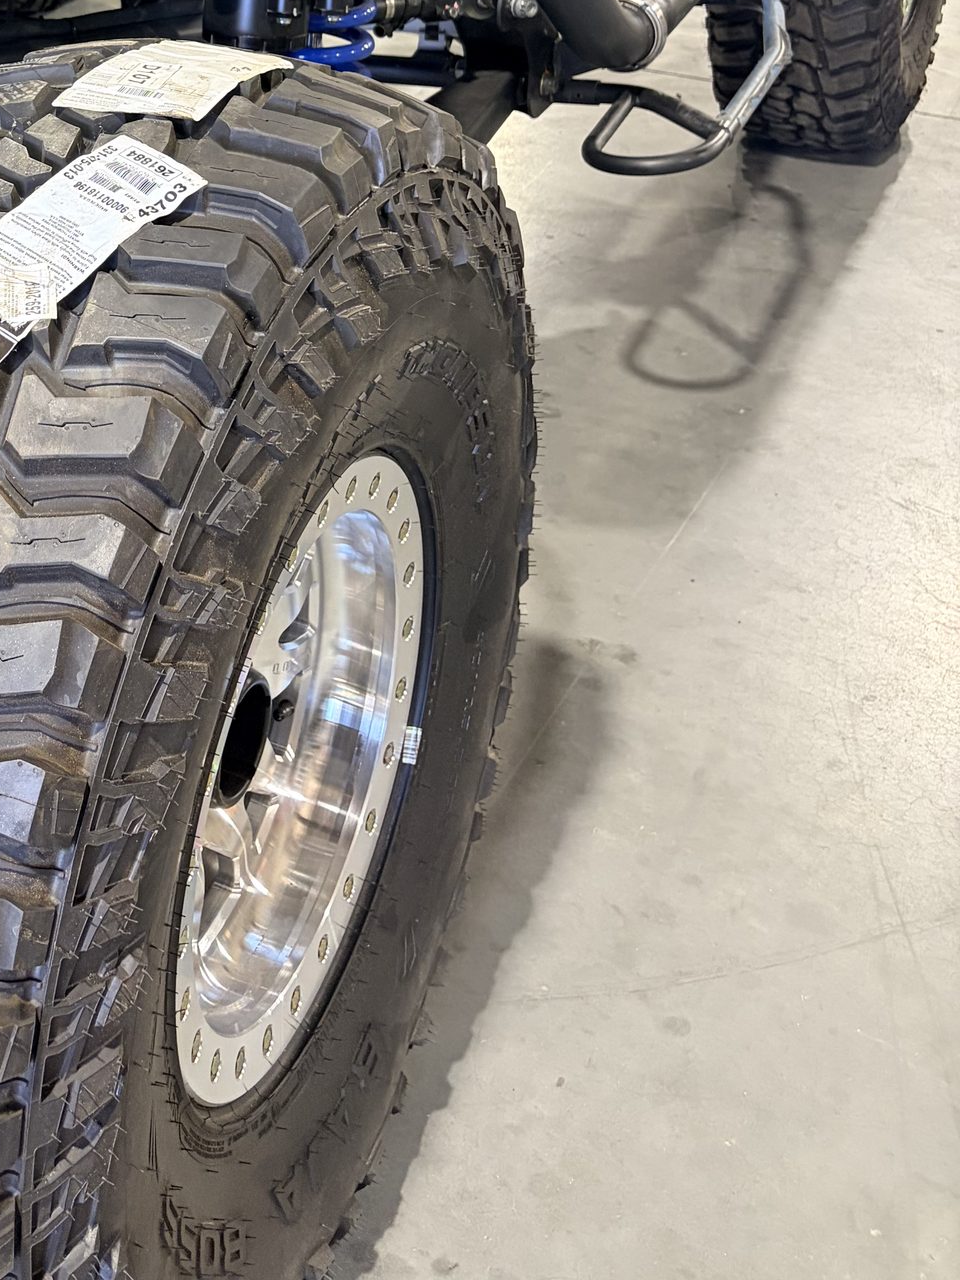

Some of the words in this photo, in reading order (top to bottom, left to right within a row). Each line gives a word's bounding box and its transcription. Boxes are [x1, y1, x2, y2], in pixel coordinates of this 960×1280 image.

[128, 64, 162, 85] D107
[125, 149, 174, 177] 261884
[138, 180, 187, 218] 43703
